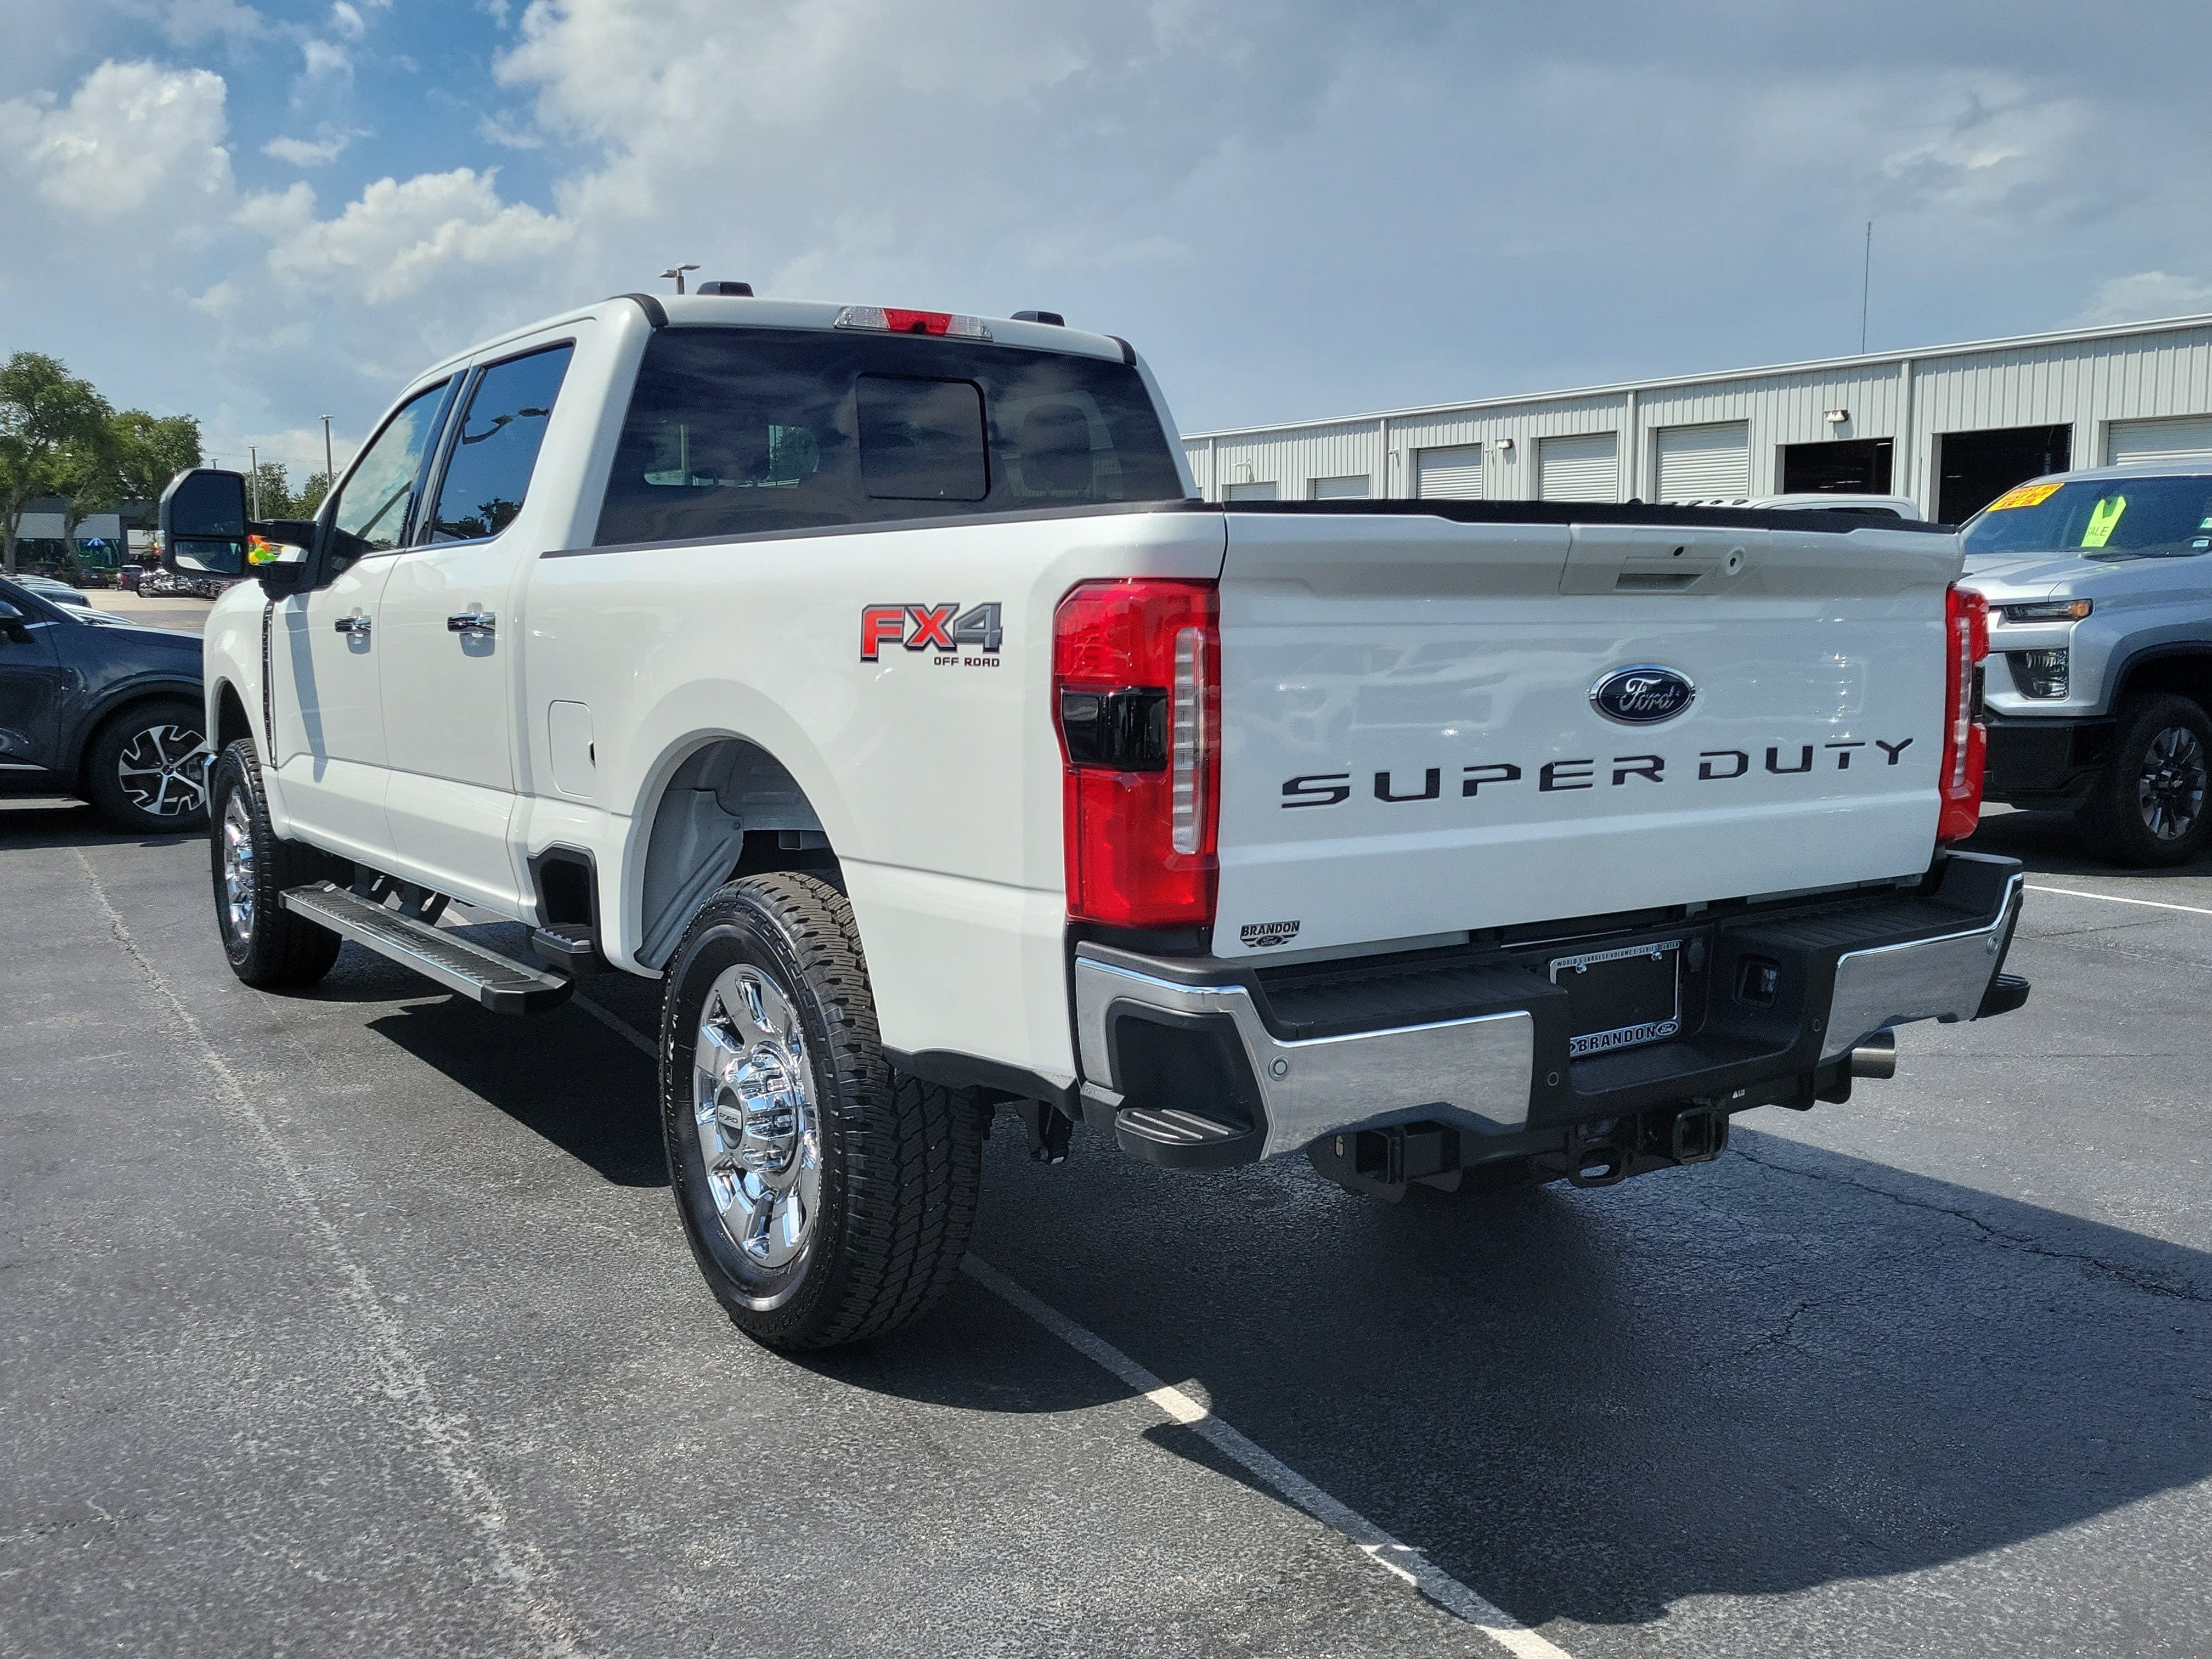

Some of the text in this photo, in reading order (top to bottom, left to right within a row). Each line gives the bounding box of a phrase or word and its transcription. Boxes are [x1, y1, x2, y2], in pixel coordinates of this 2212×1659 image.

[860, 602, 1003, 663] FX4
[934, 657, 1000, 667] OFF ROAD
[1282, 738, 1914, 809] SUPER DUTY
[1242, 921, 1300, 936] BRANDON
[1584, 953, 1609, 963] LARGEST
[1610, 950, 1632, 958] VOLUME
[1578, 1024, 1656, 1052] BRANDON
[719, 1112, 738, 1124] FORD
